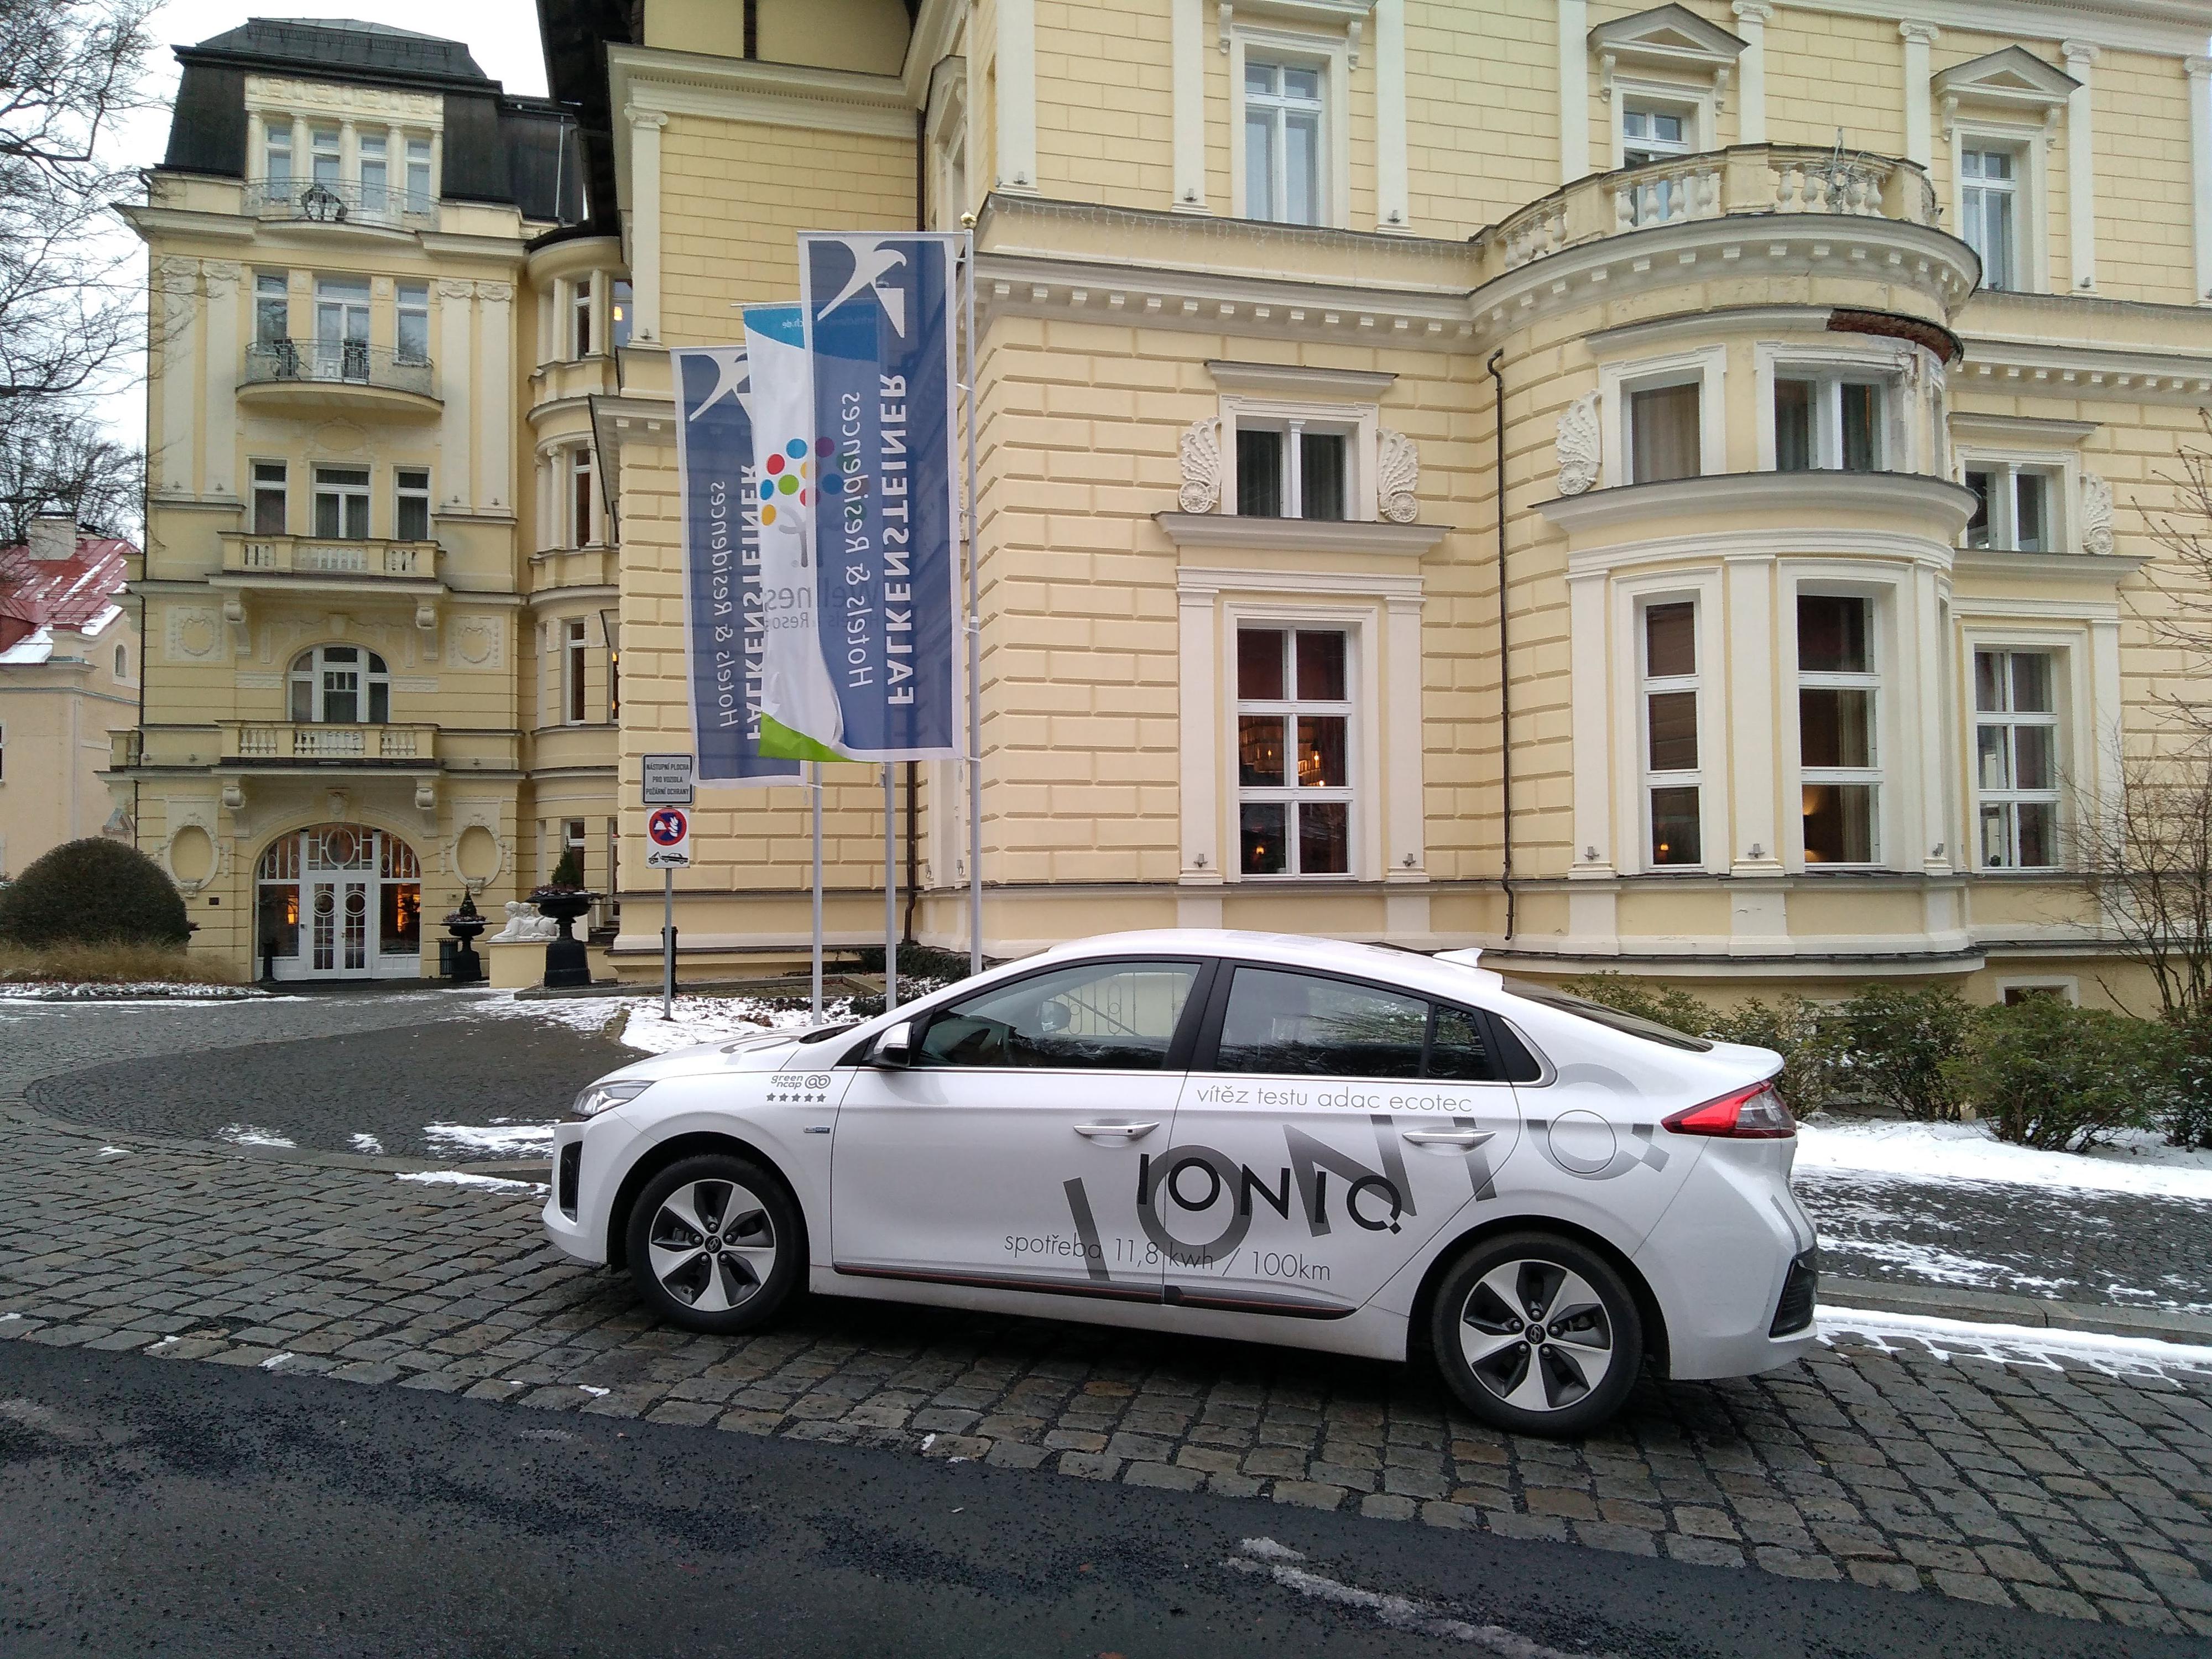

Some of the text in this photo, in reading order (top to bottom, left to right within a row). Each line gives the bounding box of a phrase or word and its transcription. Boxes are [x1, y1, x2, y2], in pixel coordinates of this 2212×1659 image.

[771, 1075, 804, 1083] green
[1197, 1085, 1472, 1112] vítěz testu adac ecotec
[1063, 1063, 1670, 1281] IONIQ
[1138, 1153, 1402, 1235] IONIQ
[1004, 1233, 1331, 1281] spotřeba 11,8 kwh / 100km
